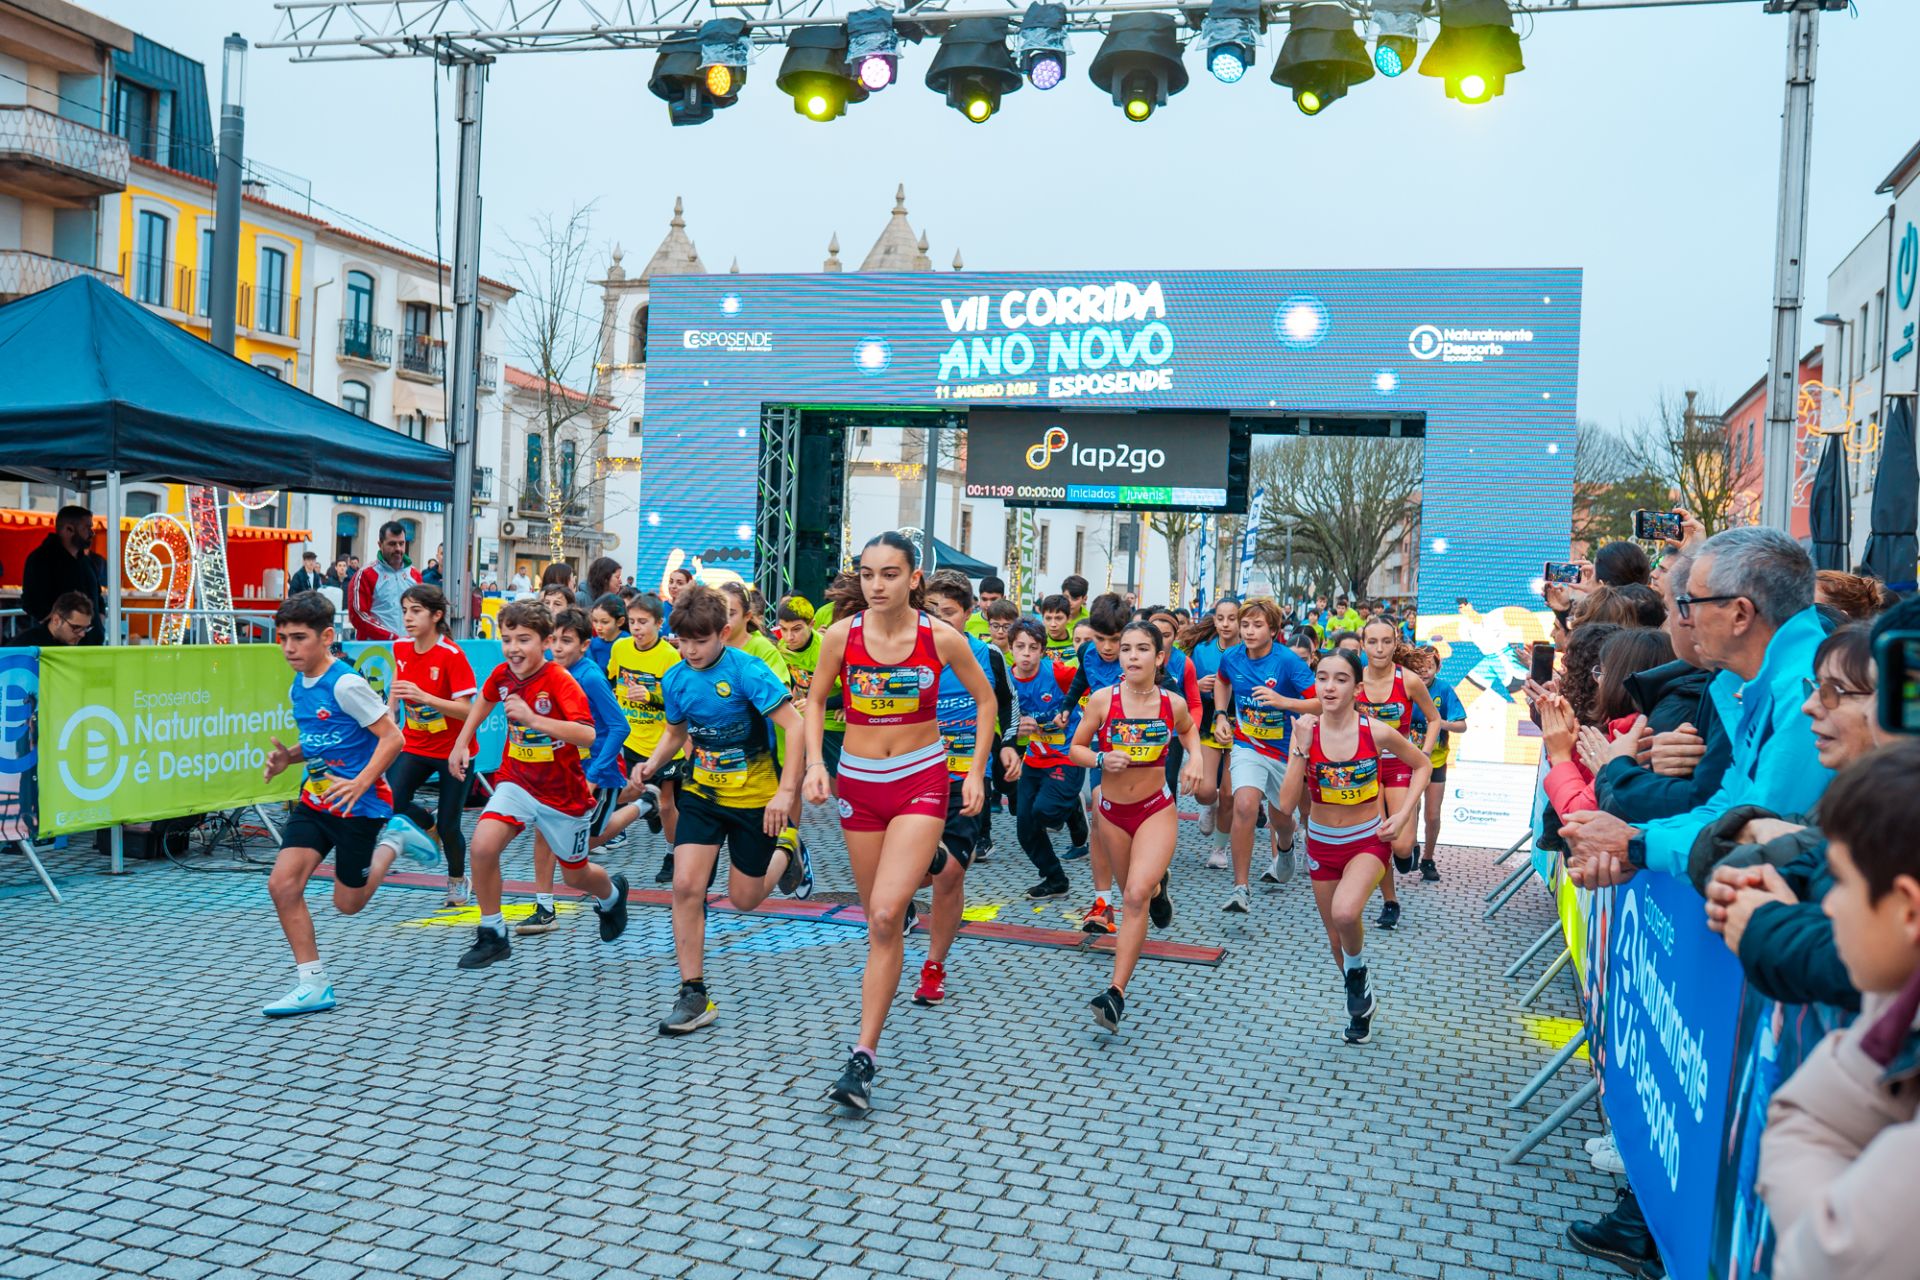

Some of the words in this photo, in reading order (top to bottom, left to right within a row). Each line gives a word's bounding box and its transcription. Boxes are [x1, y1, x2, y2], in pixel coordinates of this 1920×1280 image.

[940, 296, 990, 332] VII
[1000, 280, 1166, 329] CORRIDA
[1444, 328, 1534, 342] Naturalmente
[937, 332, 1036, 381] ANO
[1048, 322, 1174, 373] NOVO
[1443, 343, 1504, 356] Desporto
[935, 385, 950, 399] 11
[952, 383, 1004, 398] JANEIRO
[1048, 368, 1174, 398] ESPOSENDE
[1072, 442, 1166, 473] lap2go
[967, 484, 1014, 496] 00:11:09
[1017, 485, 1066, 498] 00:00:00
[1069, 486, 1116, 500] Iniciados
[134, 688, 211, 711] Esposende
[871, 699, 894, 710] 534
[134, 703, 297, 745] Naturalmente
[134, 749, 151, 784] é
[159, 742, 265, 782] Desporto
[1130, 746, 1150, 756] 537
[708, 773, 728, 783] 455
[1341, 789, 1362, 800] 531
[572, 829, 587, 855] 13
[1643, 884, 1675, 957] Esposende
[1632, 929, 1708, 1124] Naturalmente
[1635, 1028, 1680, 1193] Desporto
